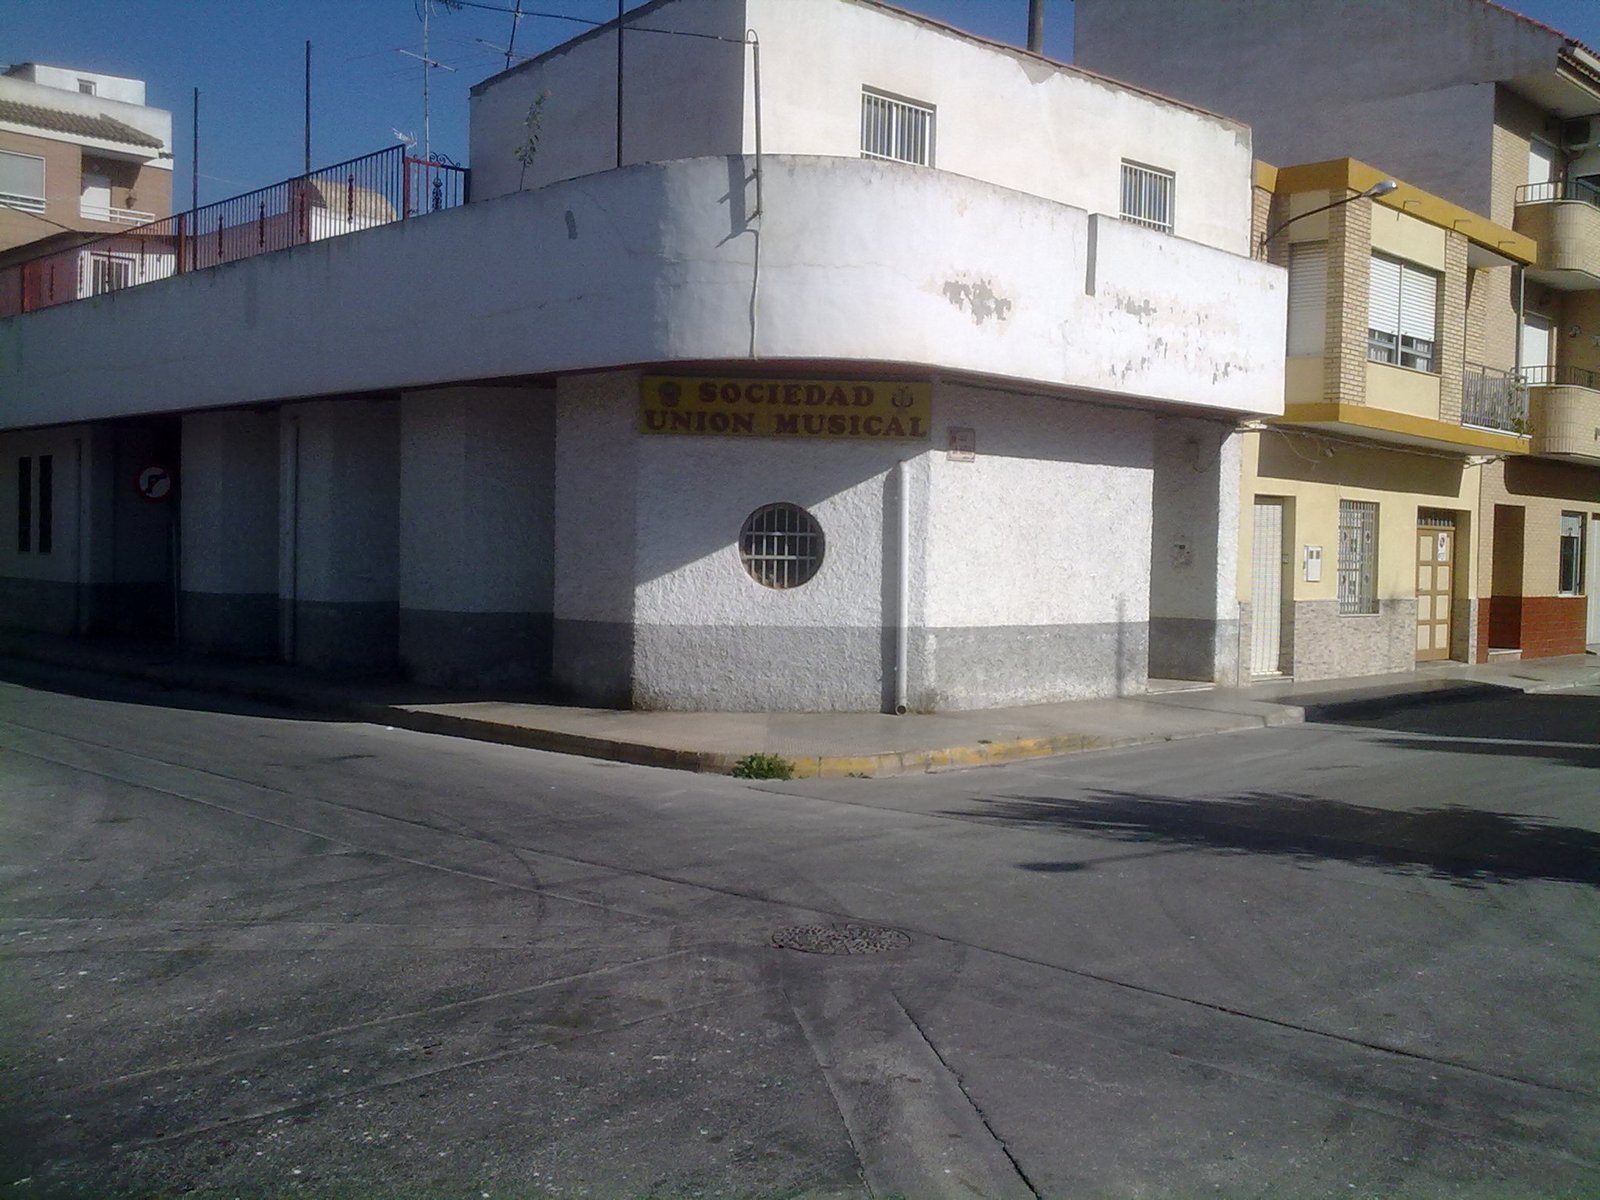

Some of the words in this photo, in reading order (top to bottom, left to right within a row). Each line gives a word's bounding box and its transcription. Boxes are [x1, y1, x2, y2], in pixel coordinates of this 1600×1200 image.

[698, 383, 874, 407] SOCIEDAD
[644, 410, 755, 433] UNION
[775, 413, 927, 438] MUSICAL
